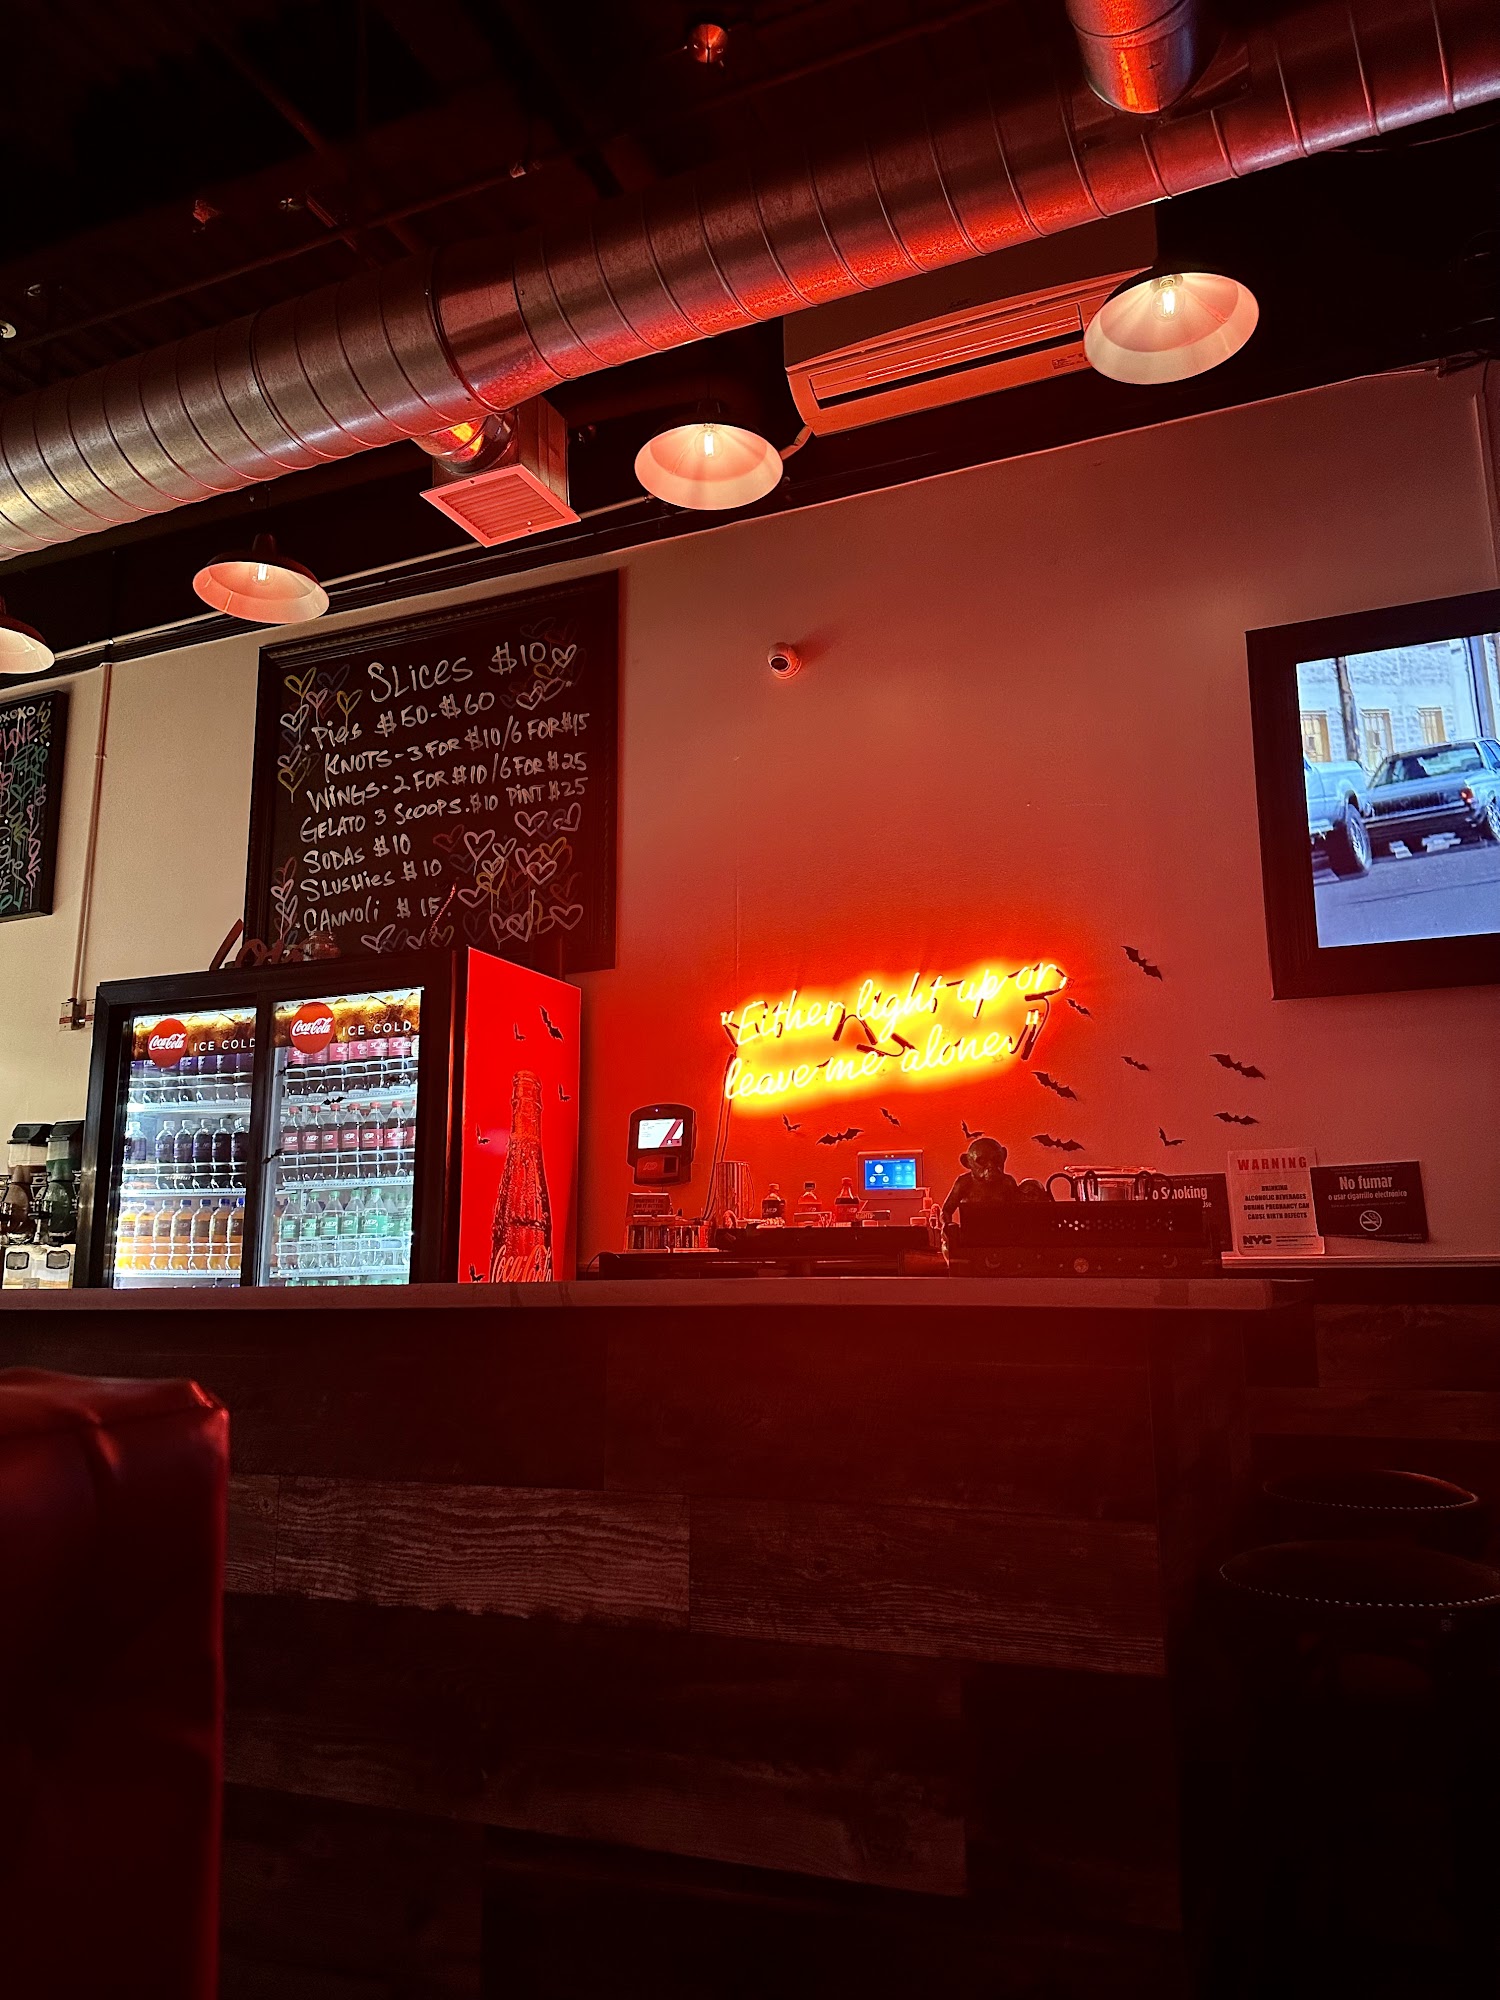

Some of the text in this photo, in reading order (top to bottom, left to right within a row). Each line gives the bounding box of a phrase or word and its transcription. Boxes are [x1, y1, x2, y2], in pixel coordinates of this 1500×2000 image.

[488, 642, 547, 675] $10
[425, 738, 462, 759] FOR
[527, 717, 563, 740] FOR
[561, 711, 590, 737] $15
[412, 769, 449, 792] FOR
[512, 756, 545, 776] FOR
[547, 751, 587, 772] $25
[300, 815, 366, 844] GELATO
[374, 808, 387, 826] 3
[548, 777, 589, 801] $25
[302, 832, 411, 874] SODAS $10
[400, 859, 442, 881] $10
[856, 971, 949, 1040] light
[954, 968, 1010, 1020] up
[291, 1017, 334, 1036] Coca-Cola
[342, 1020, 412, 1037] ICE COLD
[148, 1033, 187, 1050] Coca-Cola
[194, 1042, 215, 1052] ICE
[725, 1056, 813, 1100] leave
[824, 1054, 884, 1085] me
[1237, 1156, 1307, 1171] WARNING
[1339, 1174, 1393, 1190] No fumar
[1333, 1193, 1346, 1201] usar
[1347, 1190, 1373, 1201] cigarrillo
[1243, 1234, 1272, 1245] NYC
